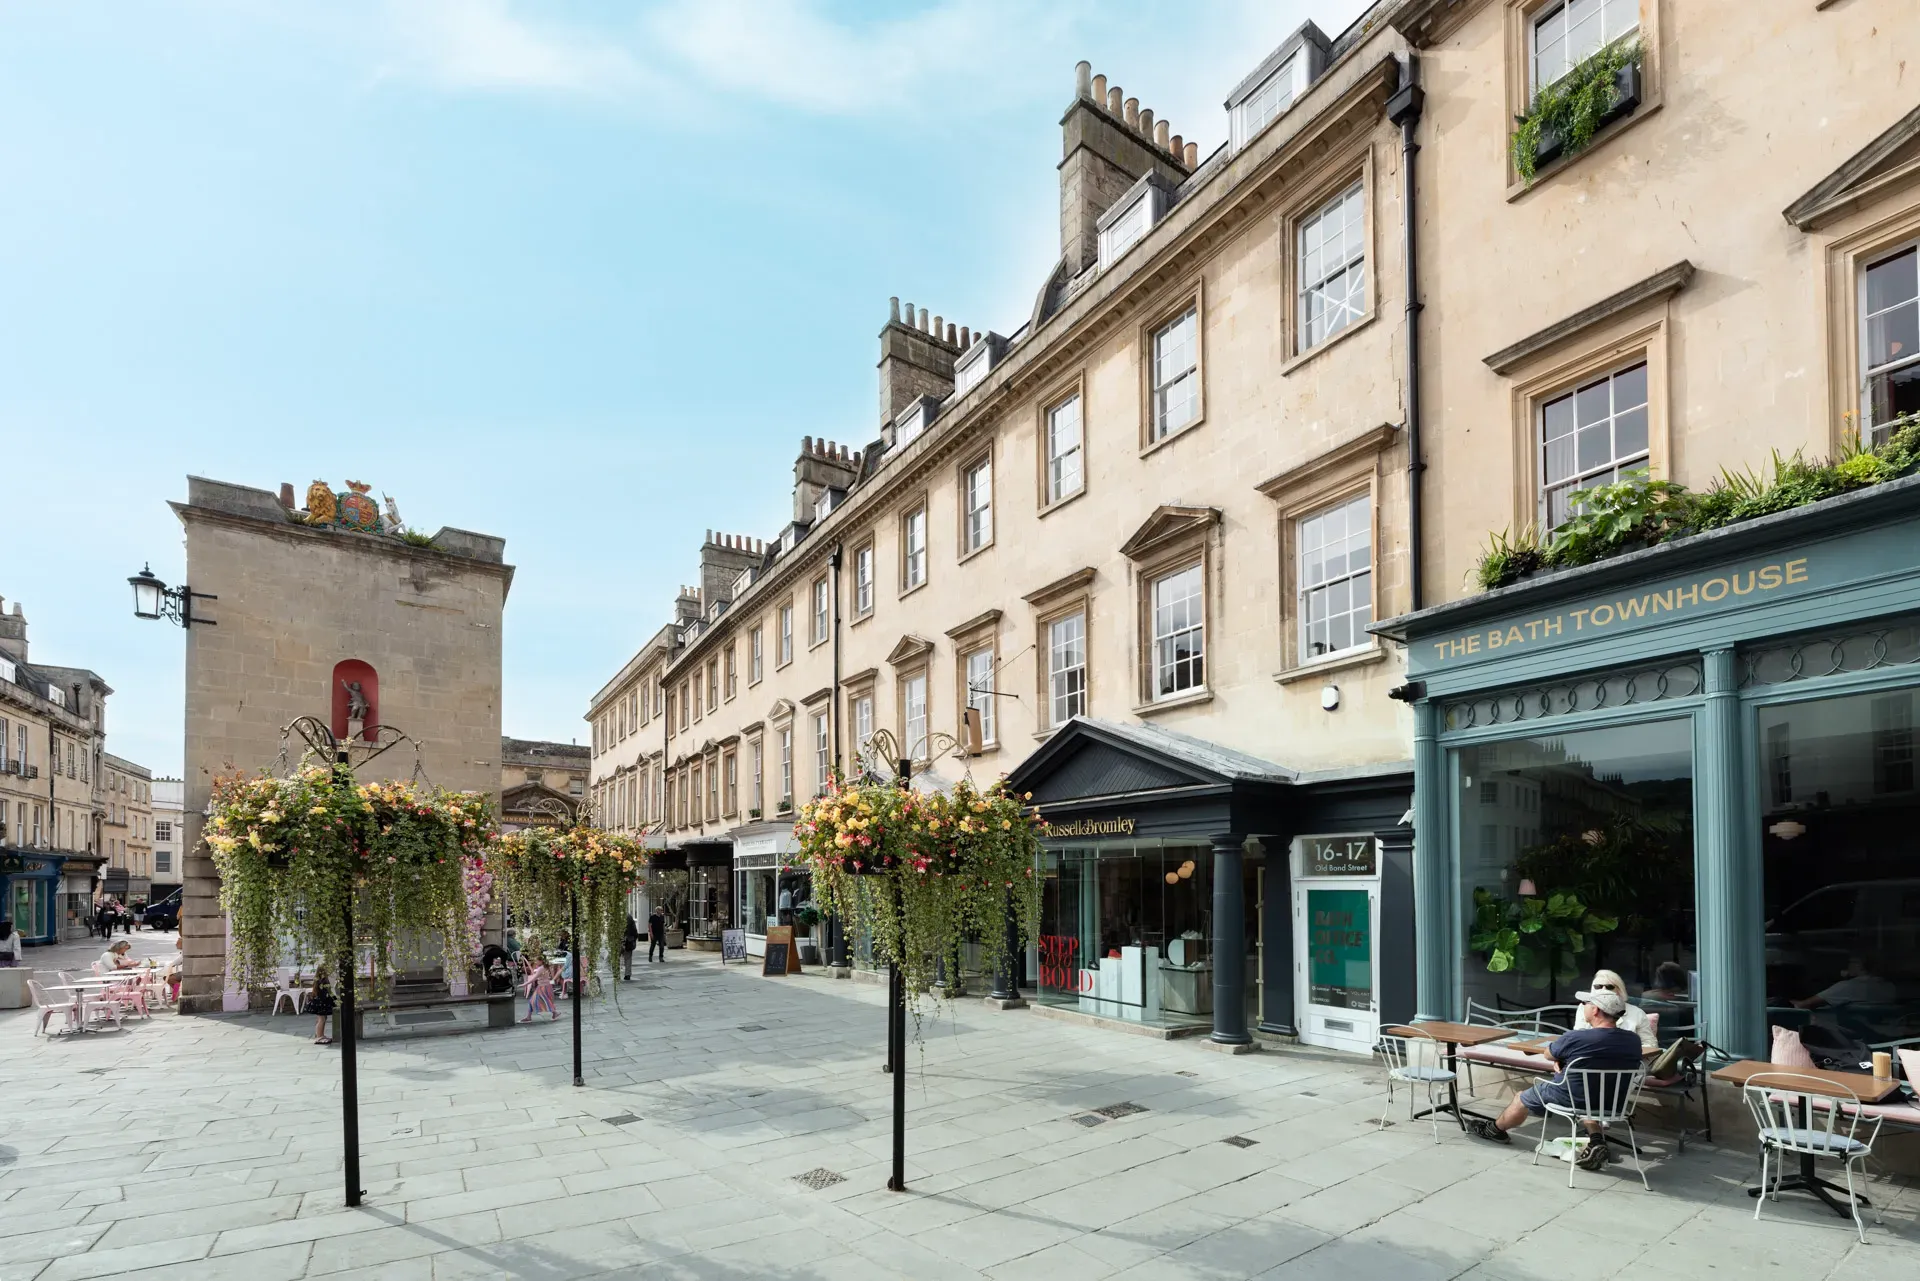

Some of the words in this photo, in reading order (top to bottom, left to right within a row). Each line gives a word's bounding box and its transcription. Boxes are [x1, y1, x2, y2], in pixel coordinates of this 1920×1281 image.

[1434, 634, 1481, 660] THE
[1488, 616, 1562, 649] BATH
[1570, 558, 1809, 630] TOWNHOUSE
[1315, 864, 1328, 872] Old
[1329, 864, 1346, 872] Bond
[1348, 863, 1368, 871] Street
[1315, 911, 1352, 926] BATH
[1038, 935, 1079, 955] STEP
[1315, 930, 1363, 947] OFFICE
[1039, 965, 1093, 992] BOLD
